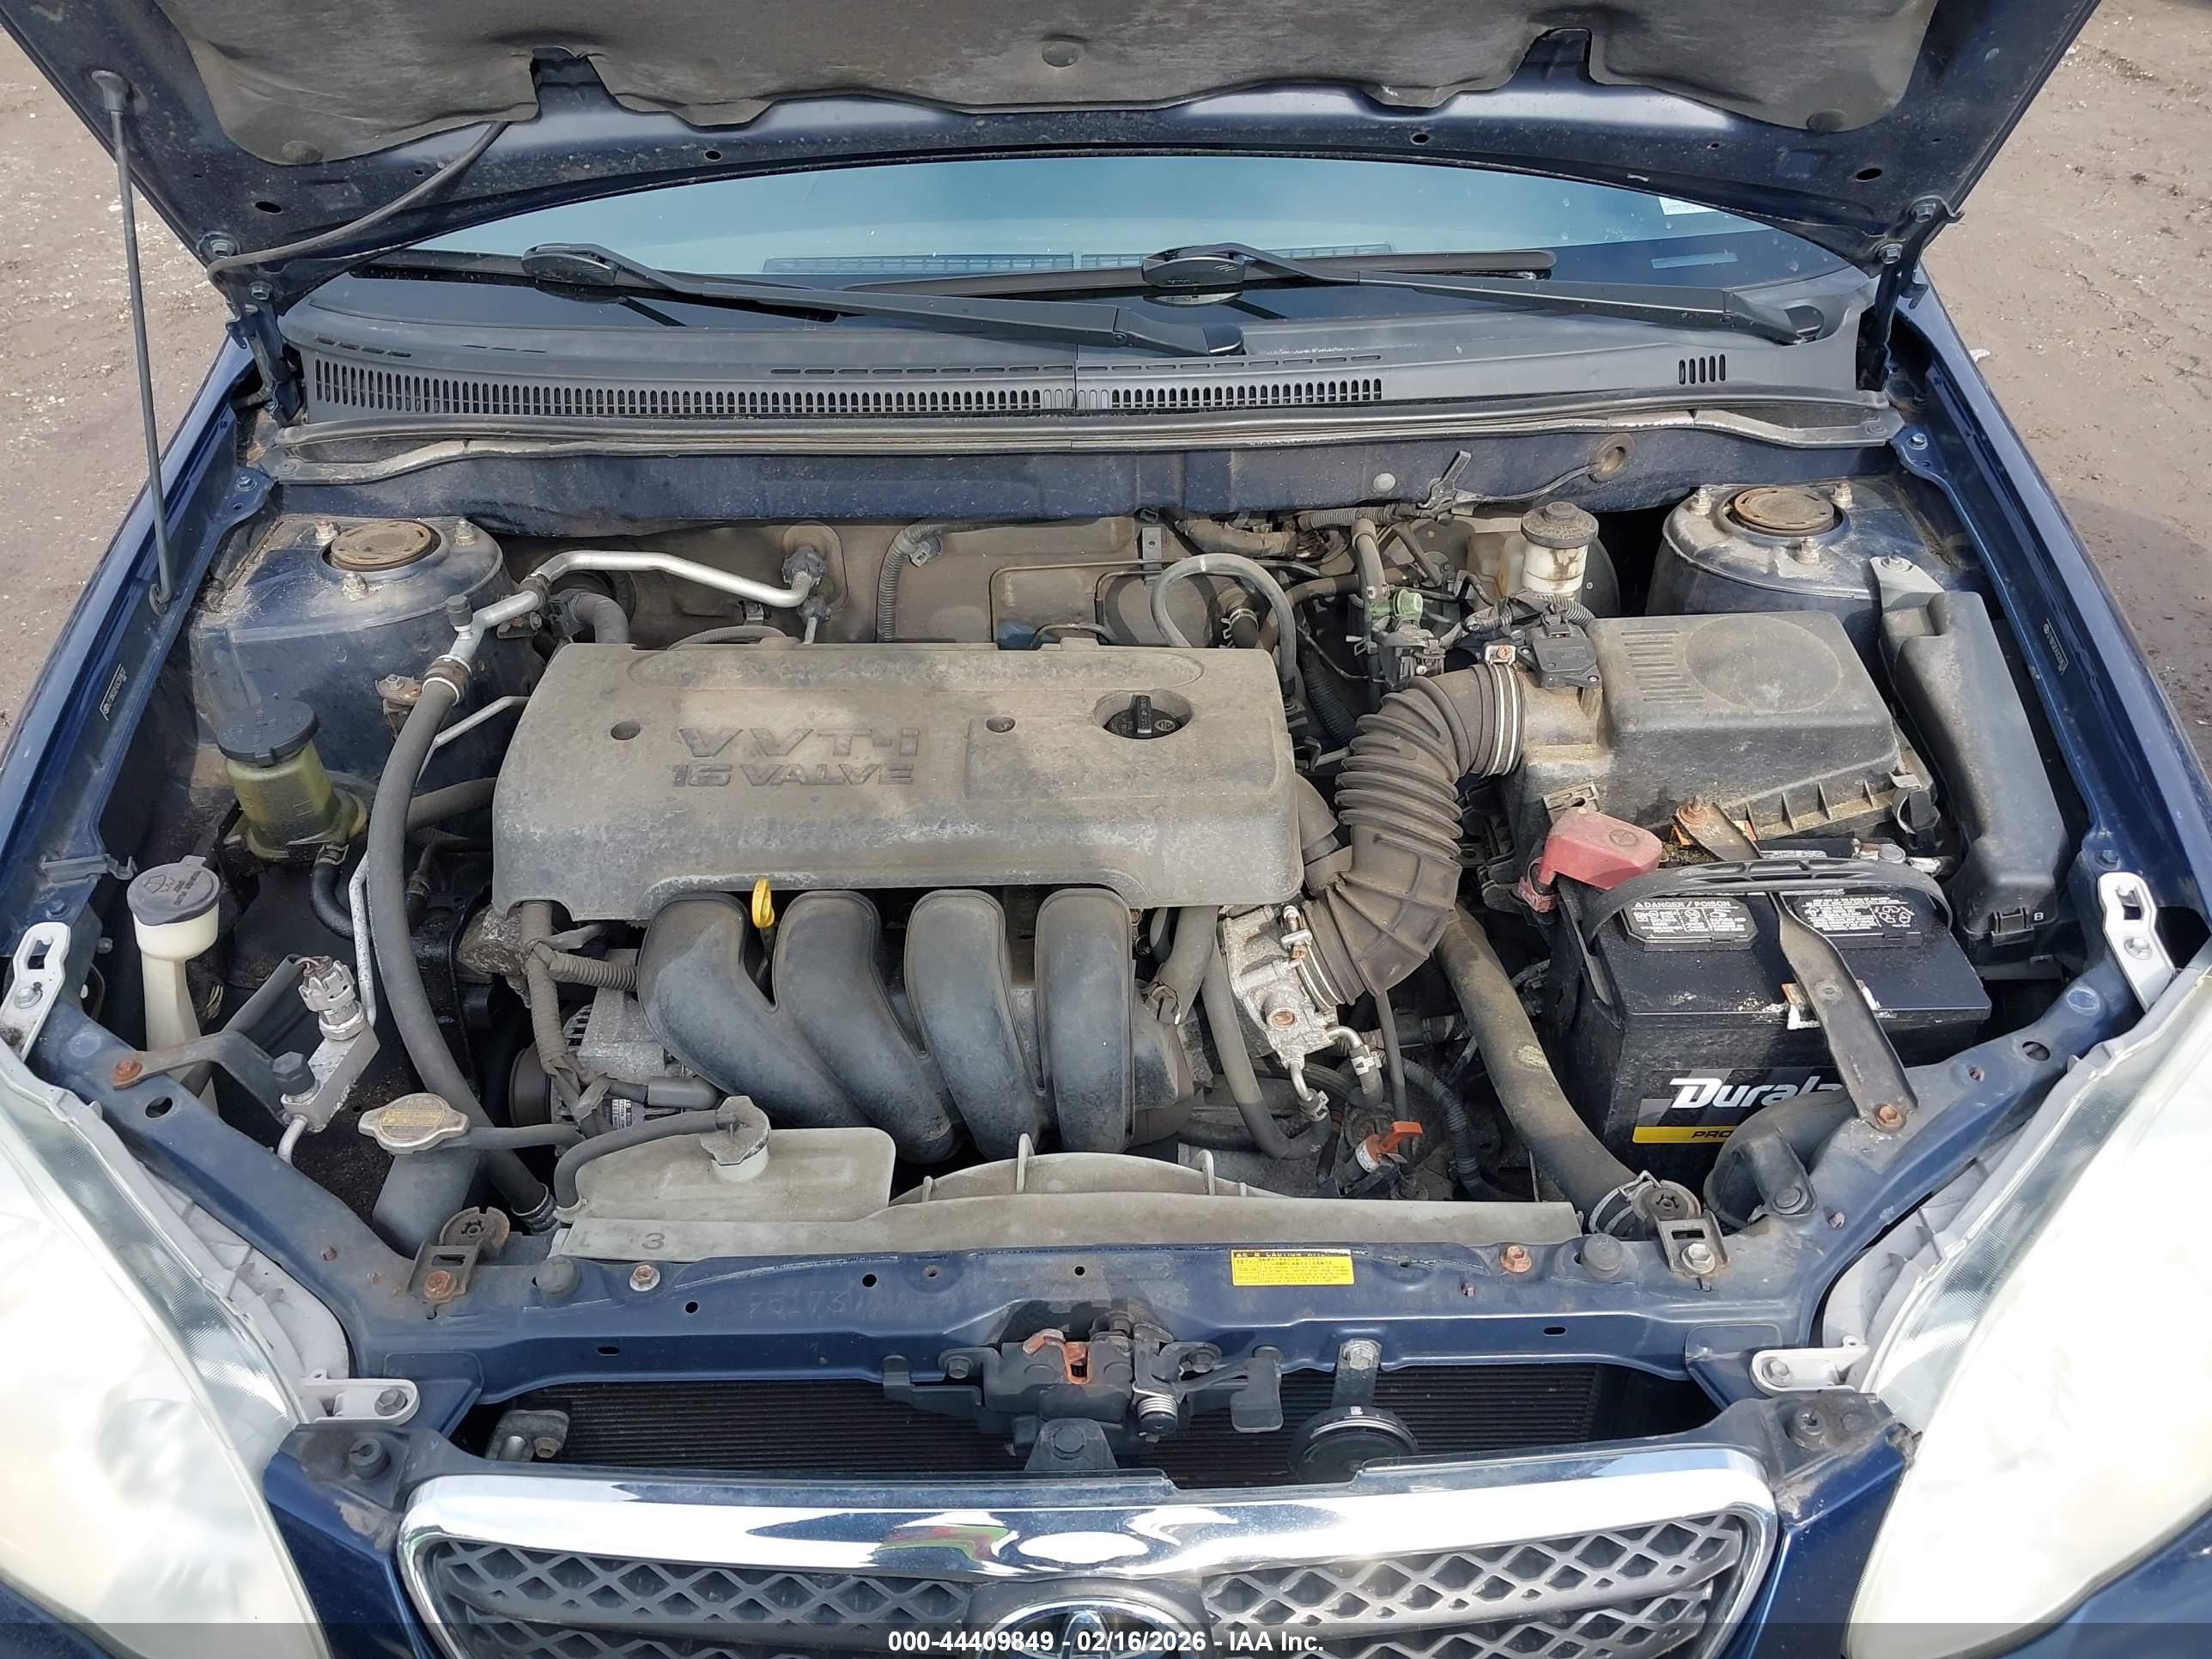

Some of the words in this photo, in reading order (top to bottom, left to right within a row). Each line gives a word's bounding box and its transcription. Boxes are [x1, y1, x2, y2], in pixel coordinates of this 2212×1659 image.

[673, 764, 732, 787] 16
[739, 763, 915, 787] VALVE
[641, 1232, 665, 1249] 3
